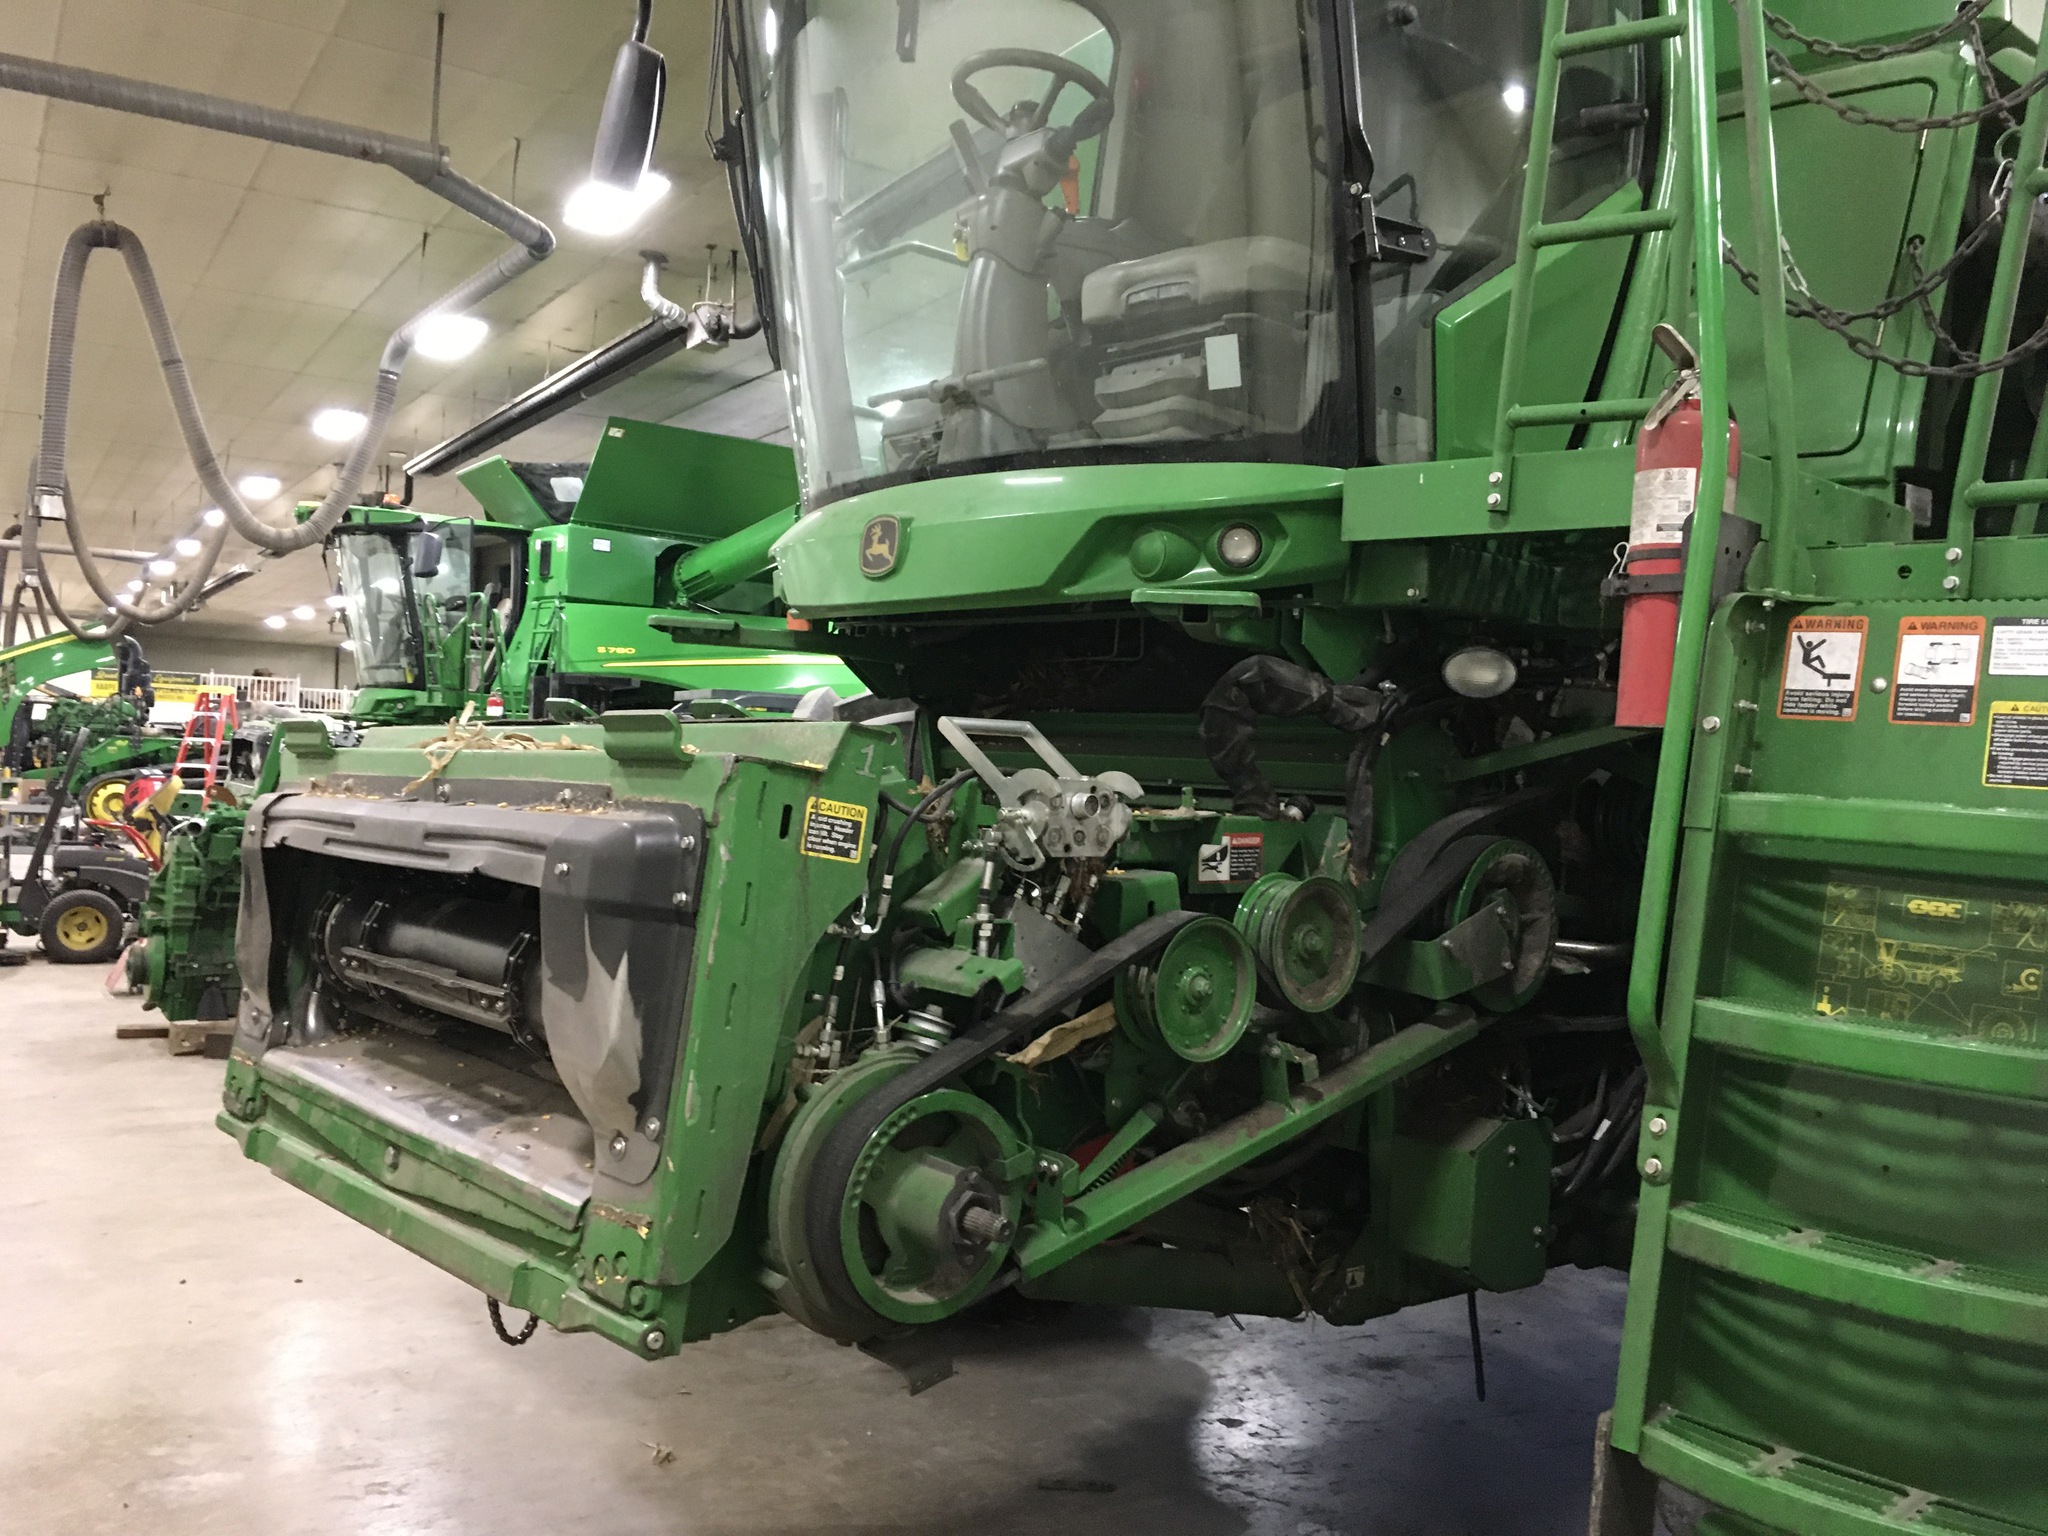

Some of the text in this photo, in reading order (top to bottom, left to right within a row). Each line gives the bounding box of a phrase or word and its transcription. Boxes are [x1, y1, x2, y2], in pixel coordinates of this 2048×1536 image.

[1806, 620, 1864, 630] WARNING
[1920, 622, 1978, 630] WARNING
[856, 744, 876, 778] 1
[820, 802, 864, 818] CAUTION
[811, 814, 828, 822] Aoid
